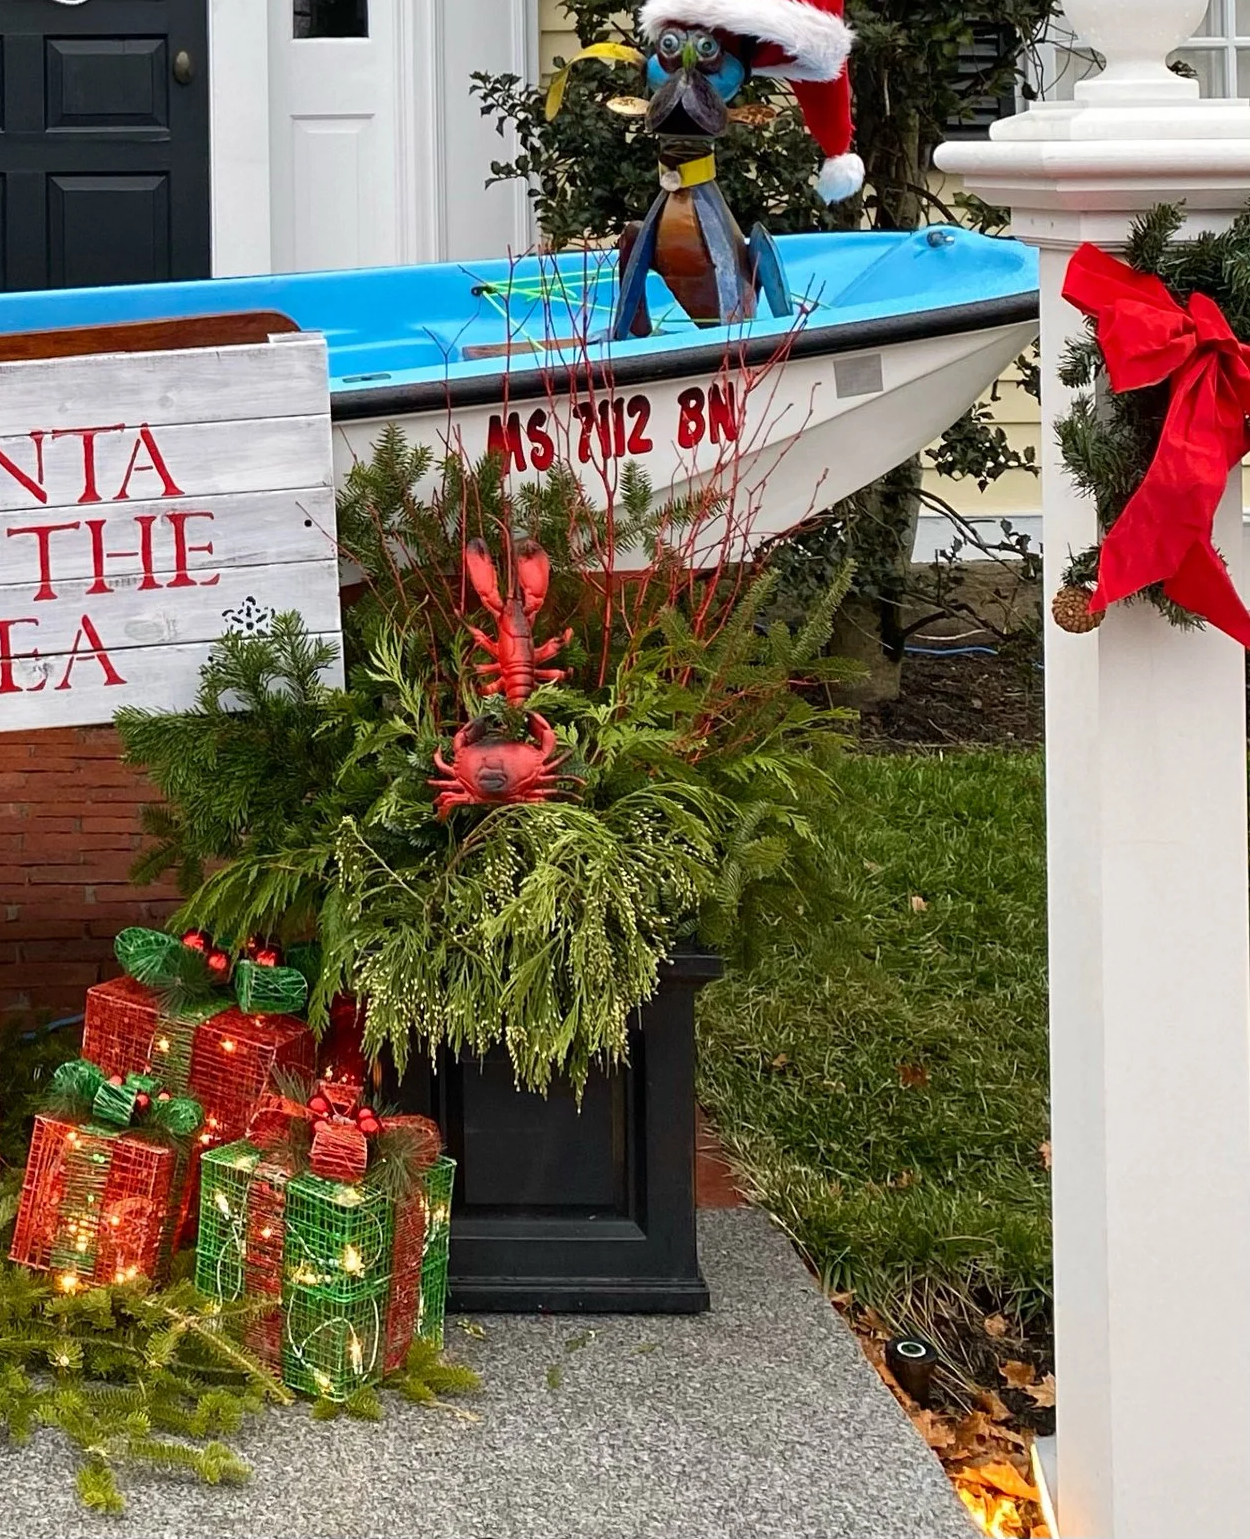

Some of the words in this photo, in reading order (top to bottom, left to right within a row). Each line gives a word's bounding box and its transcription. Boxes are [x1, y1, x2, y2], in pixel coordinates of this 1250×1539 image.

[487, 408, 554, 475] MS
[572, 395, 653, 464] 7112
[677, 381, 738, 449] BN
[6, 511, 221, 602] THE
